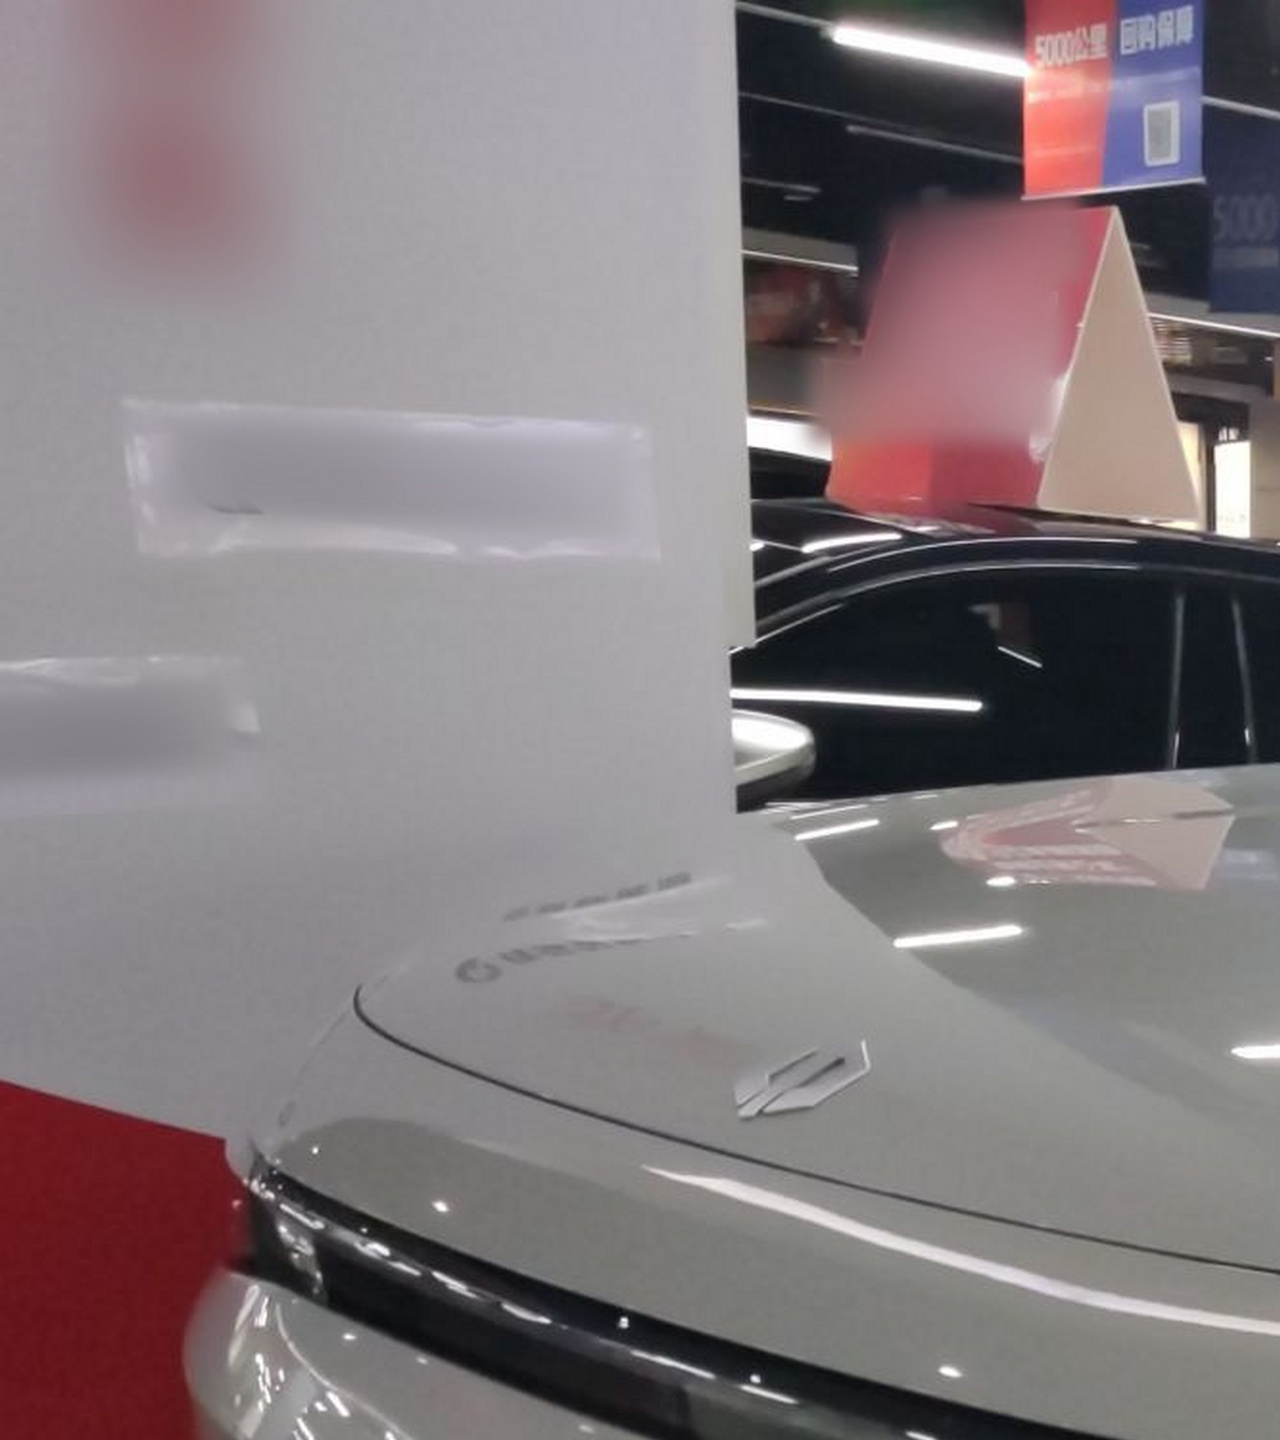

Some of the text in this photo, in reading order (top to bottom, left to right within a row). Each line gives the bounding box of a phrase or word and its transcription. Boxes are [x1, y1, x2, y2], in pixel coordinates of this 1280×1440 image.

[1034, 5, 1194, 69] 5000公里 回购保障
